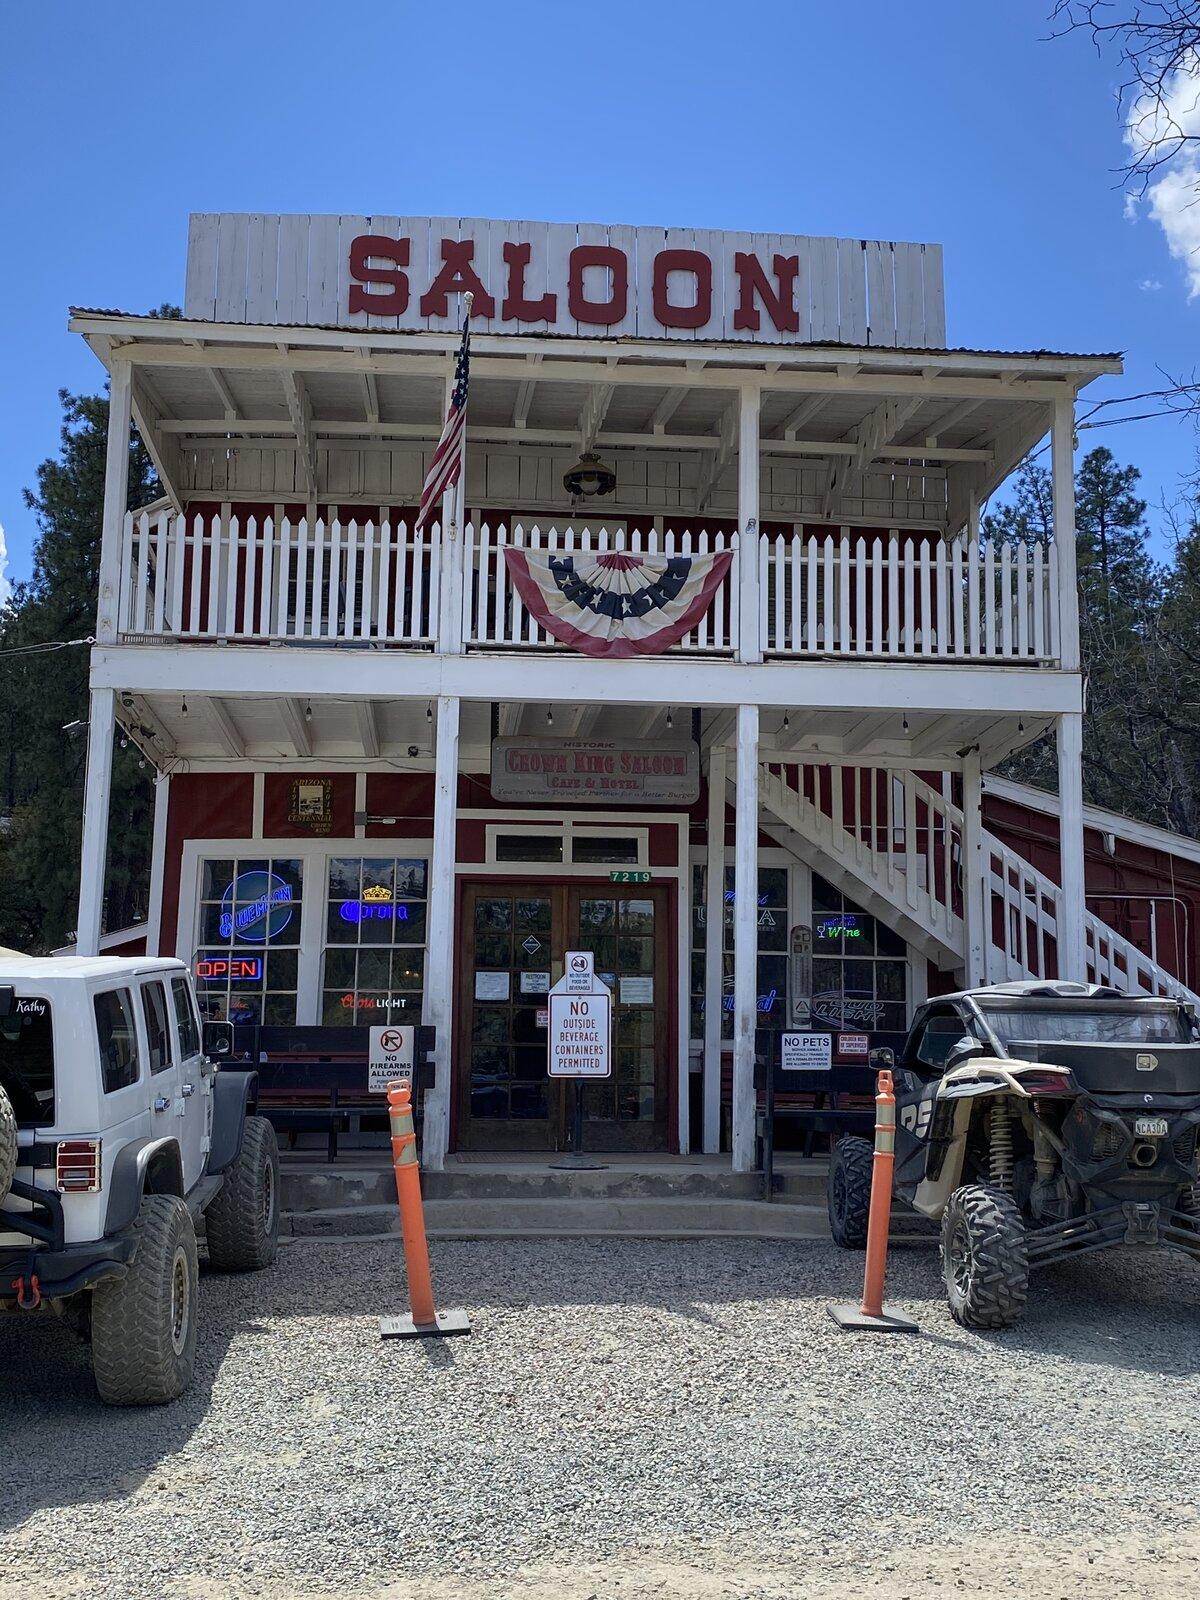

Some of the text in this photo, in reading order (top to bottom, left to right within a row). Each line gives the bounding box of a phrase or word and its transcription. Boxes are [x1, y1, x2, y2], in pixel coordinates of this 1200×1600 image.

[349, 234, 800, 333] SALOON
[508, 750, 685, 776] CROWN KING SALOON
[291, 779, 332, 787] ARIZONA
[584, 777, 594, 788] &
[600, 777, 640, 789] HOTEL
[641, 791, 665, 799] Better
[611, 872, 650, 882] 7219
[339, 900, 408, 925] Corona
[828, 926, 860, 938] Wine
[196, 961, 256, 977] OPEN
[16, 1000, 46, 1016] Kathy
[376, 999, 407, 1008] LIGHT
[570, 1001, 589, 1015] NO
[815, 1004, 886, 1023] LIGHT
[563, 1019, 596, 1029] OUTSIDE
[560, 1032, 599, 1042] BEVERAGE
[784, 1037, 830, 1047] NO PETS
[555, 1045, 604, 1055] CONTAINERS
[558, 1058, 600, 1068] PERMITTED
